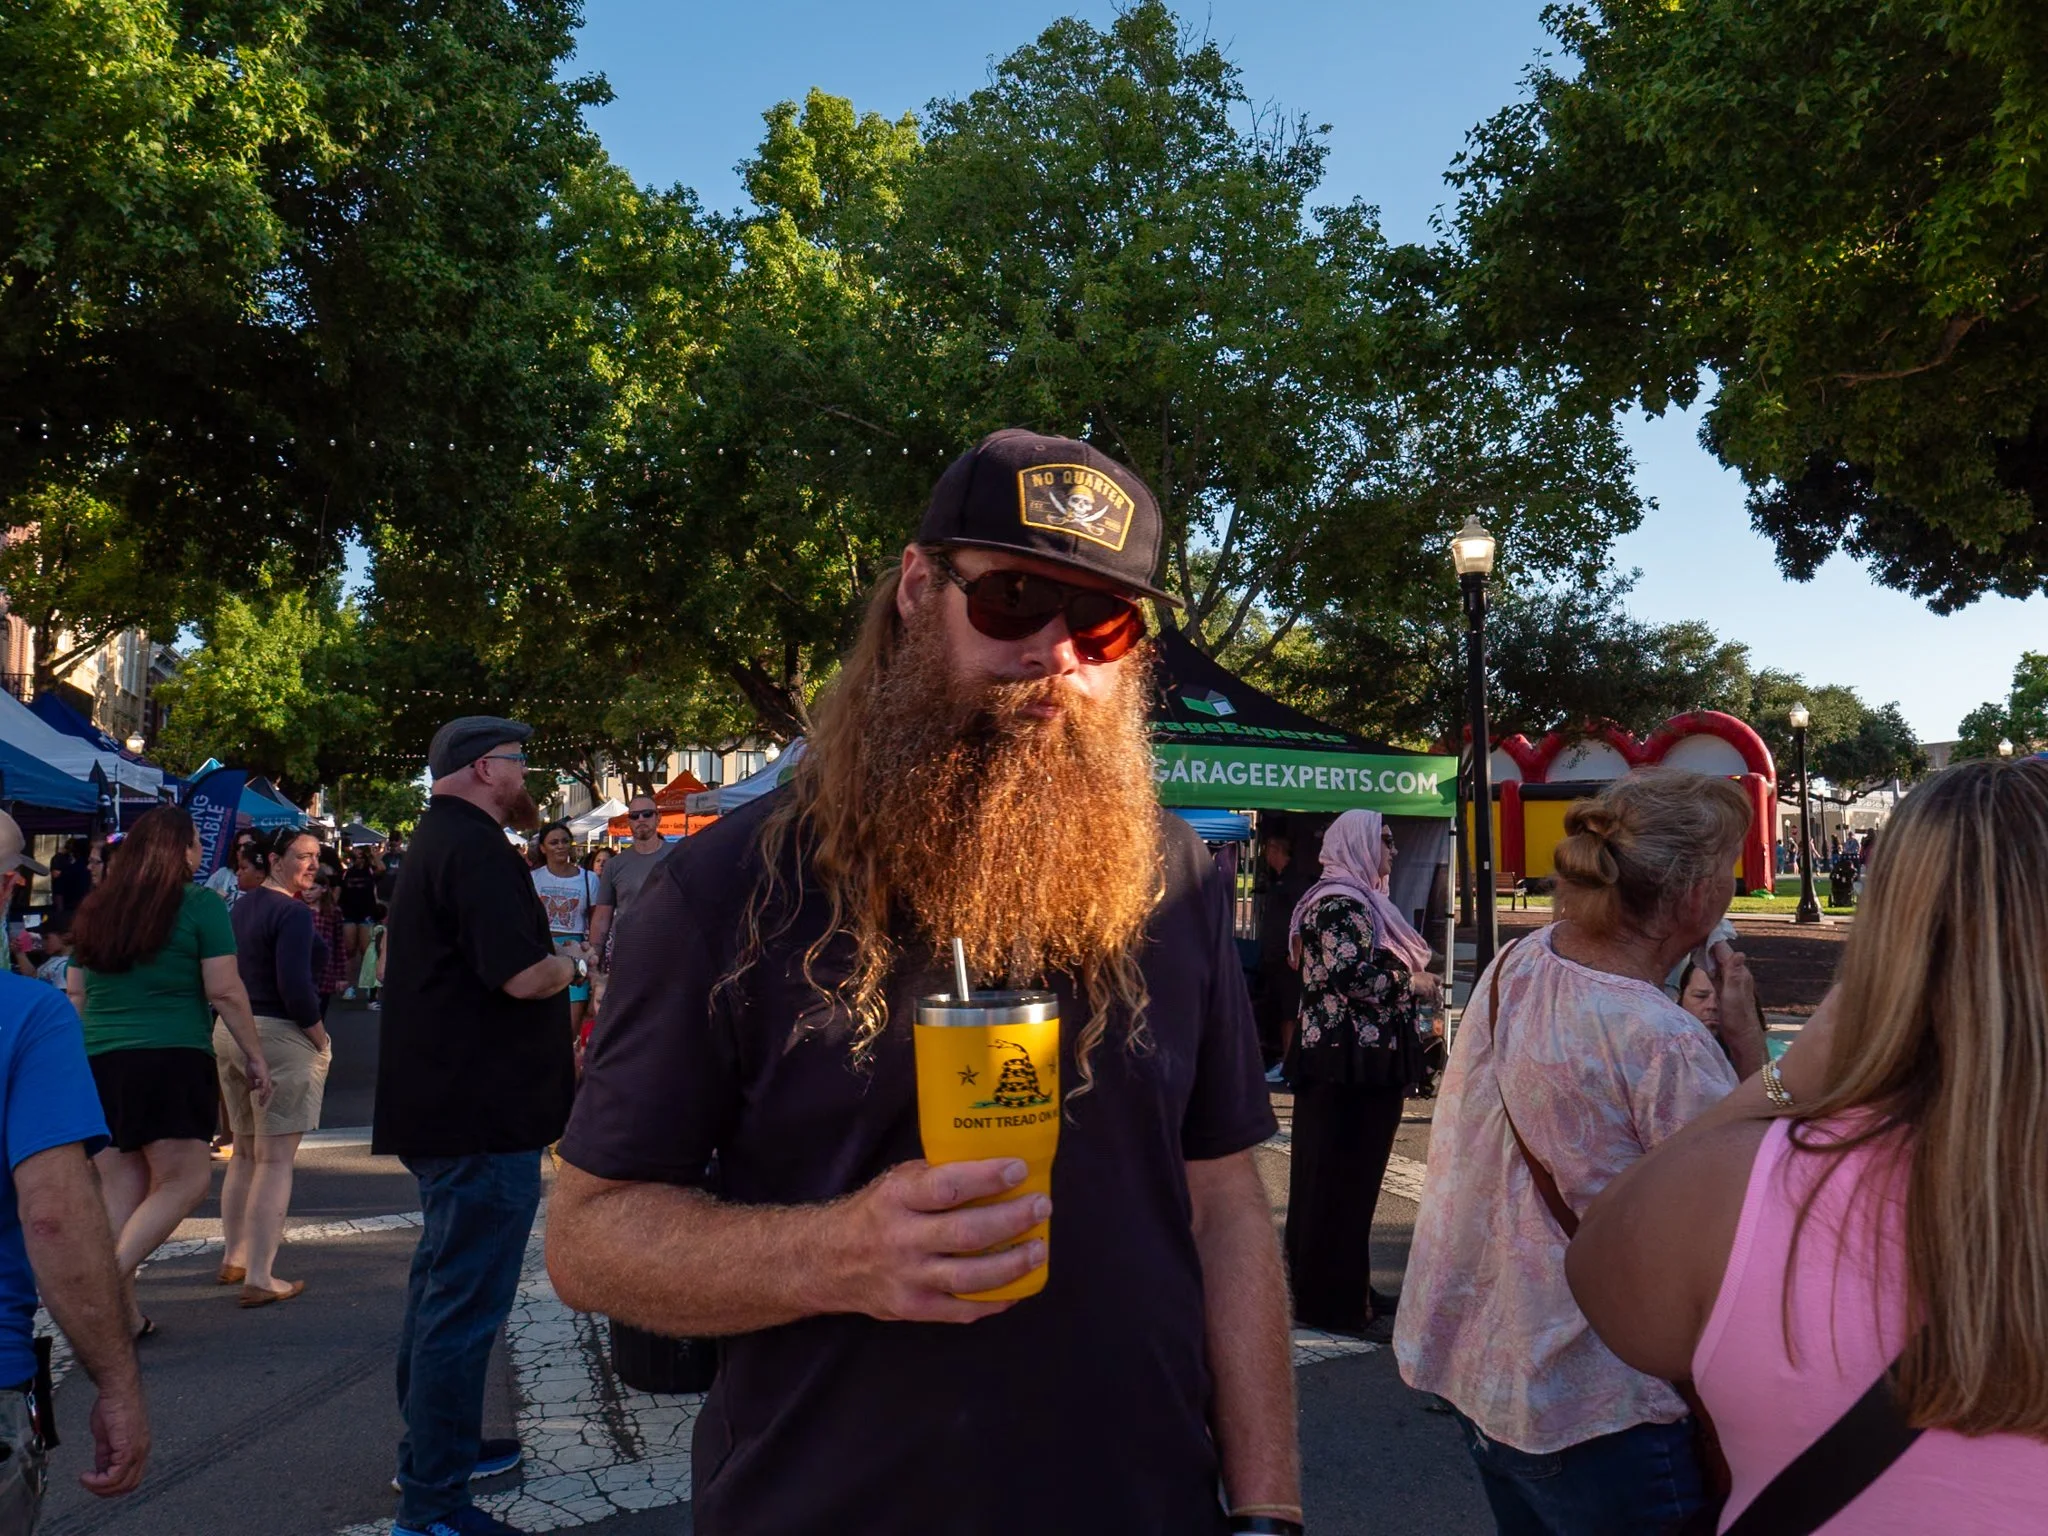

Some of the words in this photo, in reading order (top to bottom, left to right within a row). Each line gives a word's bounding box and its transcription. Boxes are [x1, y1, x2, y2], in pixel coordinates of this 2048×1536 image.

[1031, 471, 1054, 487] NO
[1063, 470, 1125, 510] QUARTER
[1151, 758, 1438, 796] GARAGEEXPERTS.COM
[953, 1117, 993, 1129] DONT
[995, 1113, 1037, 1128] TREAD
